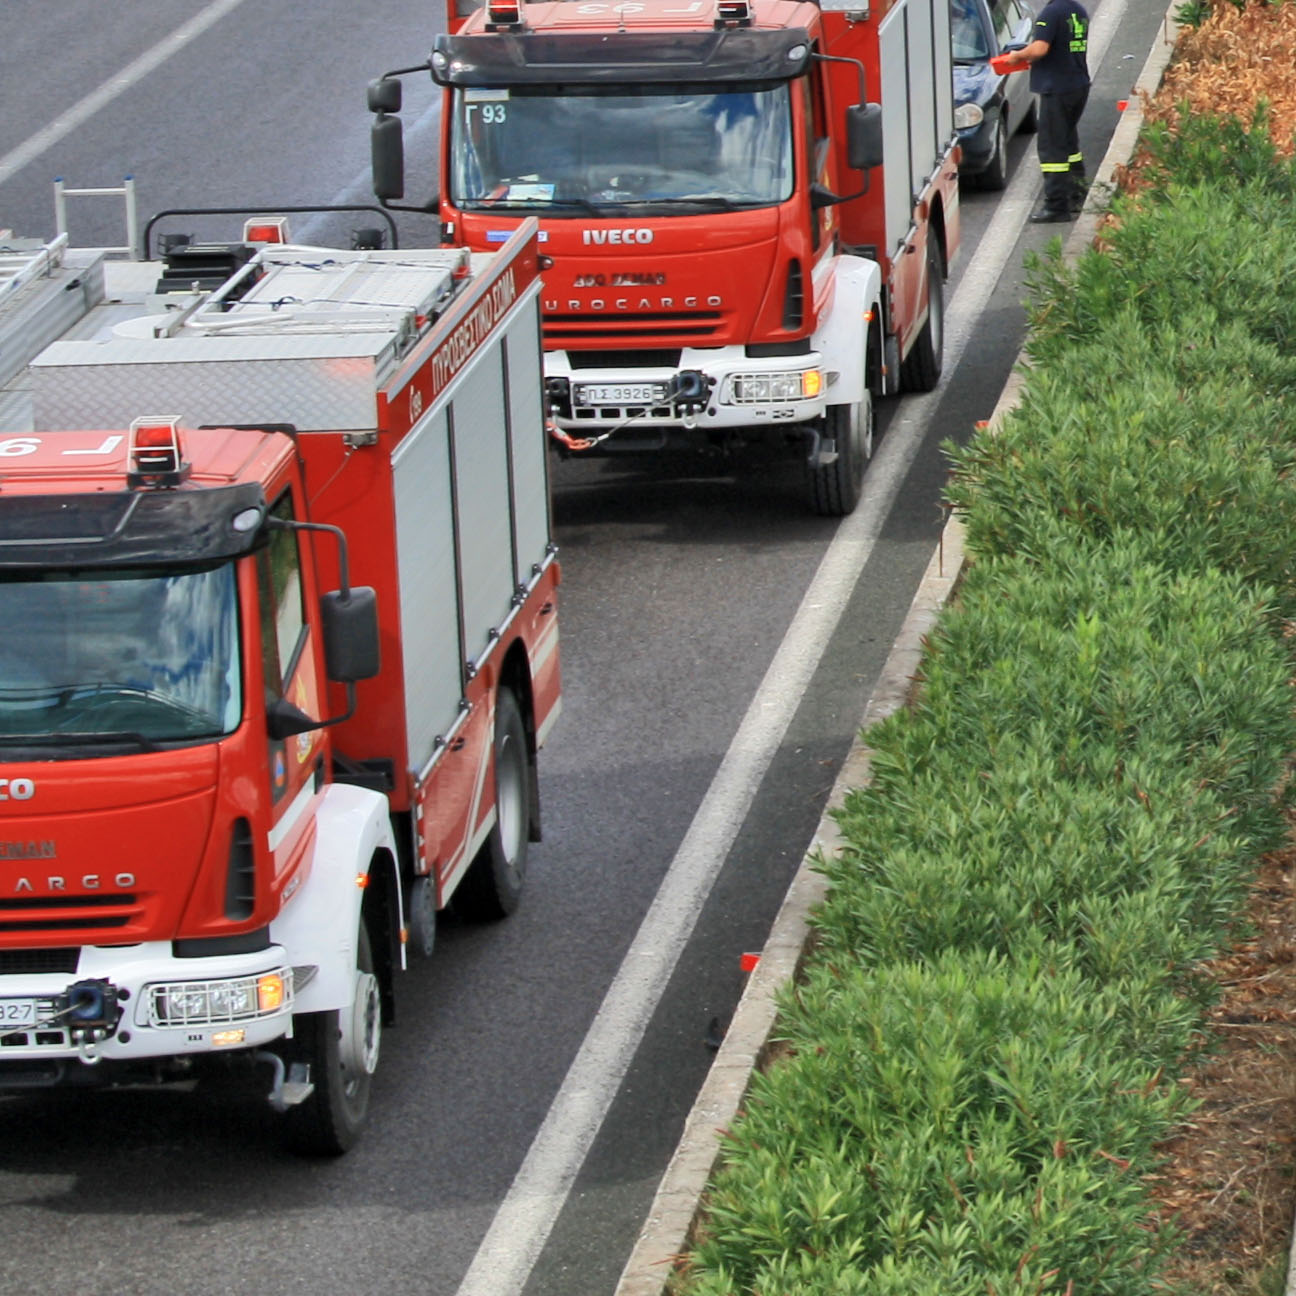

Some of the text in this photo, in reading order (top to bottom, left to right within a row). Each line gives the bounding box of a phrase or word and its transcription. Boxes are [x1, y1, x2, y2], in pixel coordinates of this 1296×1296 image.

[465, 105, 506, 124] Γ 93
[582, 229, 653, 245] IVECO
